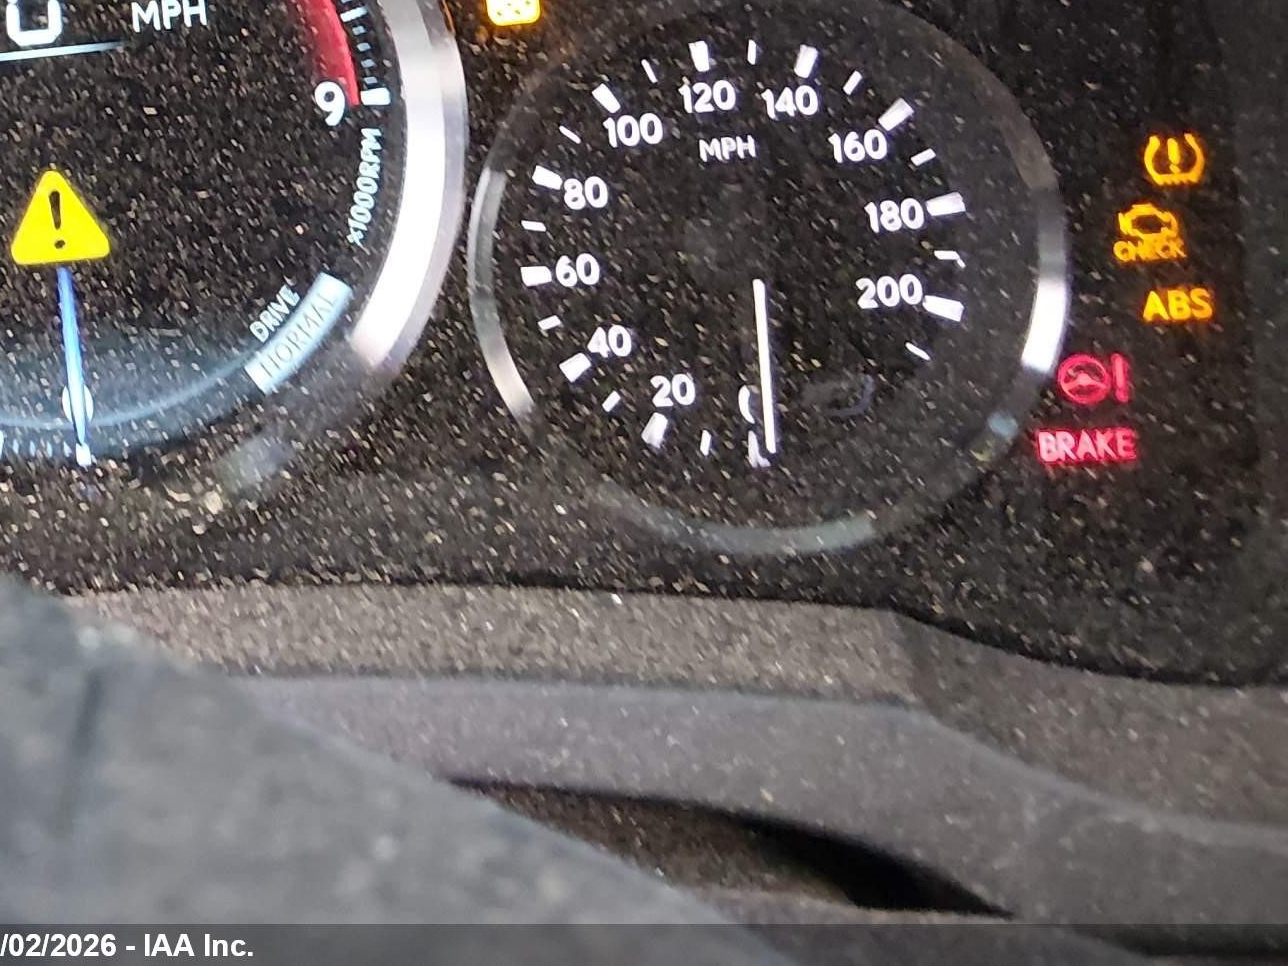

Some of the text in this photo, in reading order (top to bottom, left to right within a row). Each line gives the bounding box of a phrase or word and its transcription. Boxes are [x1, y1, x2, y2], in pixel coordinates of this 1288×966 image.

[315, 81, 346, 127] 9
[678, 79, 736, 113] 120
[761, 85, 819, 120] 140
[603, 113, 663, 147] 100
[828, 129, 888, 164] 160
[699, 135, 756, 163] MPH
[563, 175, 609, 210] 80
[864, 198, 925, 235] 180
[555, 253, 601, 288] 60
[856, 274, 924, 310] 200
[1142, 288, 1213, 322] ABS
[249, 284, 300, 343] DRIVE
[587, 324, 632, 358] 40
[650, 373, 696, 408] 20
[1037, 427, 1137, 463] BRAKE
